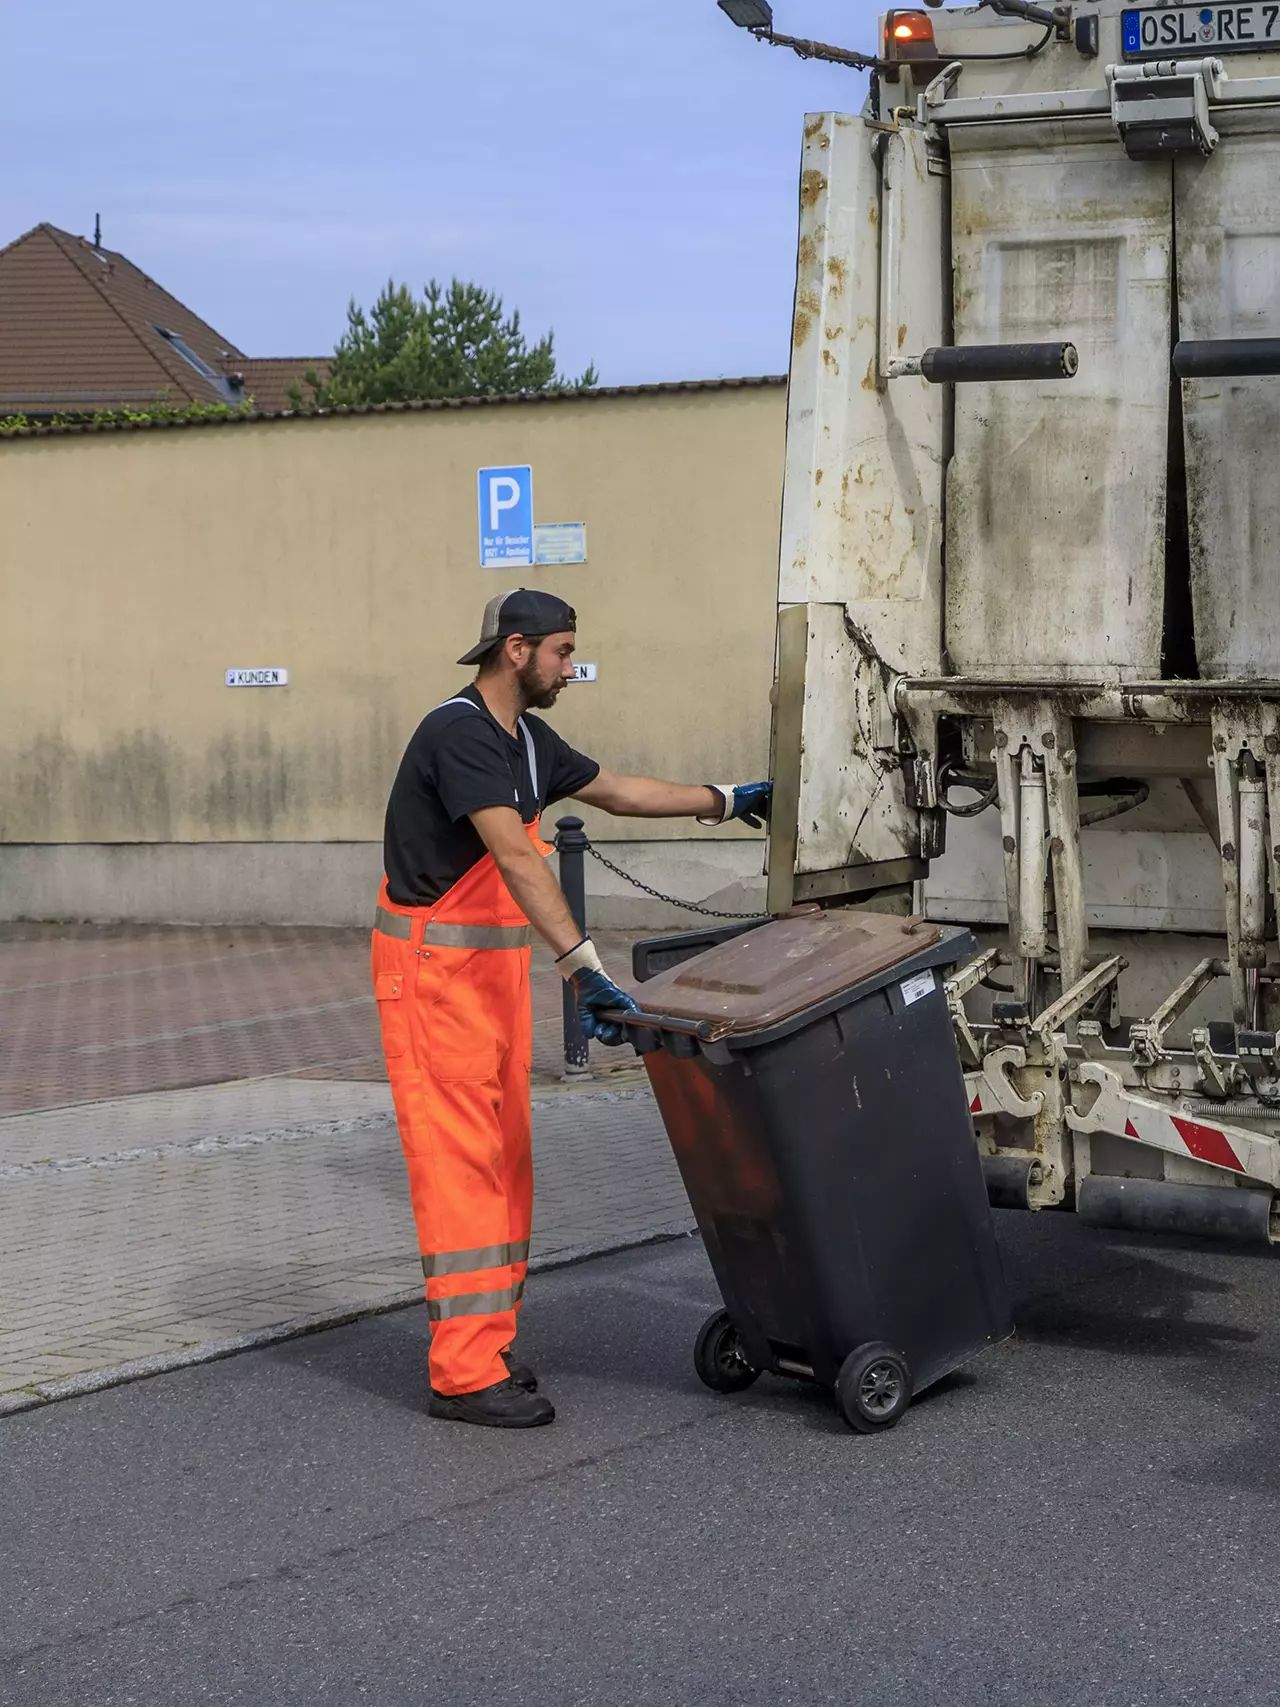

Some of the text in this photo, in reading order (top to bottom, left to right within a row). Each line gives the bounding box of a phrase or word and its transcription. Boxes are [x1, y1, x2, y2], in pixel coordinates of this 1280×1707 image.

[1128, 35, 1136, 45] D
[1141, 13, 1196, 46] OSL
[1217, 8, 1254, 41] RE
[489, 477, 521, 530] P
[237, 670, 279, 684] KUNDEN
